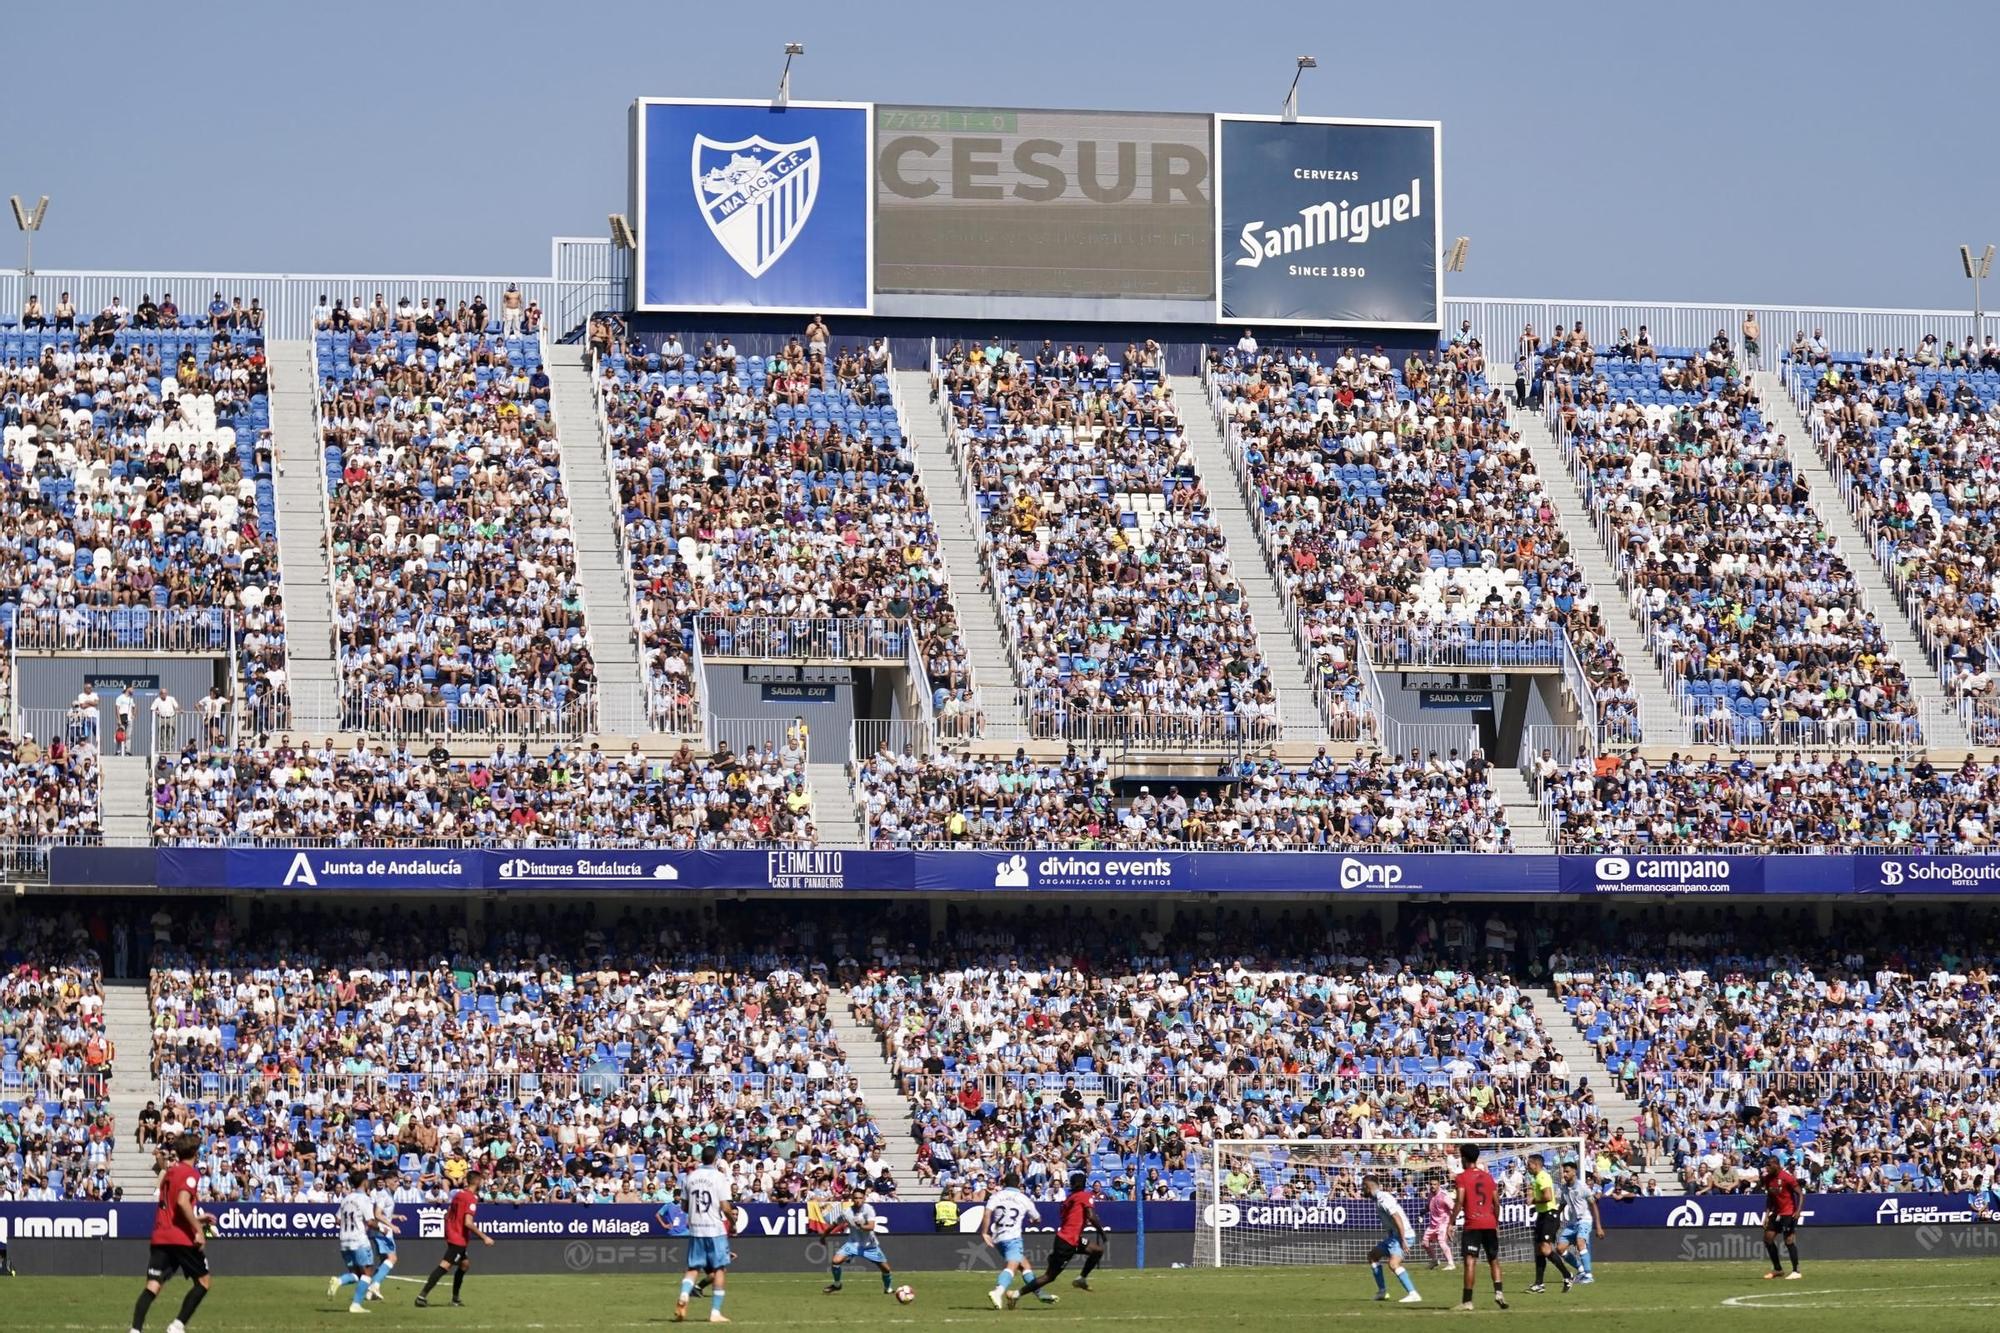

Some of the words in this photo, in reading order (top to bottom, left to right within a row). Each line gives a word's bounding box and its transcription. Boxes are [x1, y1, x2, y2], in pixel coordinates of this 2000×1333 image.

[878, 135, 1210, 204] CESUR
[1293, 167, 1360, 182] CERVEZAS
[1289, 265, 1328, 278] SINCE
[1332, 266, 1366, 279] 1890
[94, 679, 125, 689] SALIDA
[131, 679, 151, 688] EXIT
[770, 687, 803, 696] SALIDA
[808, 688, 828, 697] EXIT
[1429, 694, 1460, 703] SALIDA
[1465, 694, 1484, 703] EXIT
[320, 860, 364, 875] Junta
[366, 860, 386, 875] de
[388, 859, 462, 875] Andalucía
[515, 858, 574, 878] Pinturas
[768, 851, 842, 883] FERMENTO
[1039, 856, 1100, 876] divina
[1105, 857, 1172, 877] events
[1636, 860, 1730, 883] campano
[772, 877, 790, 889] CASA
[792, 877, 801, 889] DE
[804, 877, 844, 889] PANADEROS
[1039, 877, 1111, 886] ORGANIZACIÓN
[1595, 882, 1730, 893] www.hermanoscampano.com
[690, 1188, 713, 1214] 19
[1474, 1182, 1487, 1206] 5
[218, 1207, 287, 1230] divina
[292, 1212, 341, 1230] eve
[994, 1205, 1020, 1228] 23
[1247, 1205, 1347, 1230] campano
[473, 1218, 564, 1234] untamiento
[568, 1218, 589, 1234] de
[592, 1218, 650, 1237] Málaga
[1950, 1225, 2000, 1249] vith
[596, 1246, 679, 1263] DFSK
